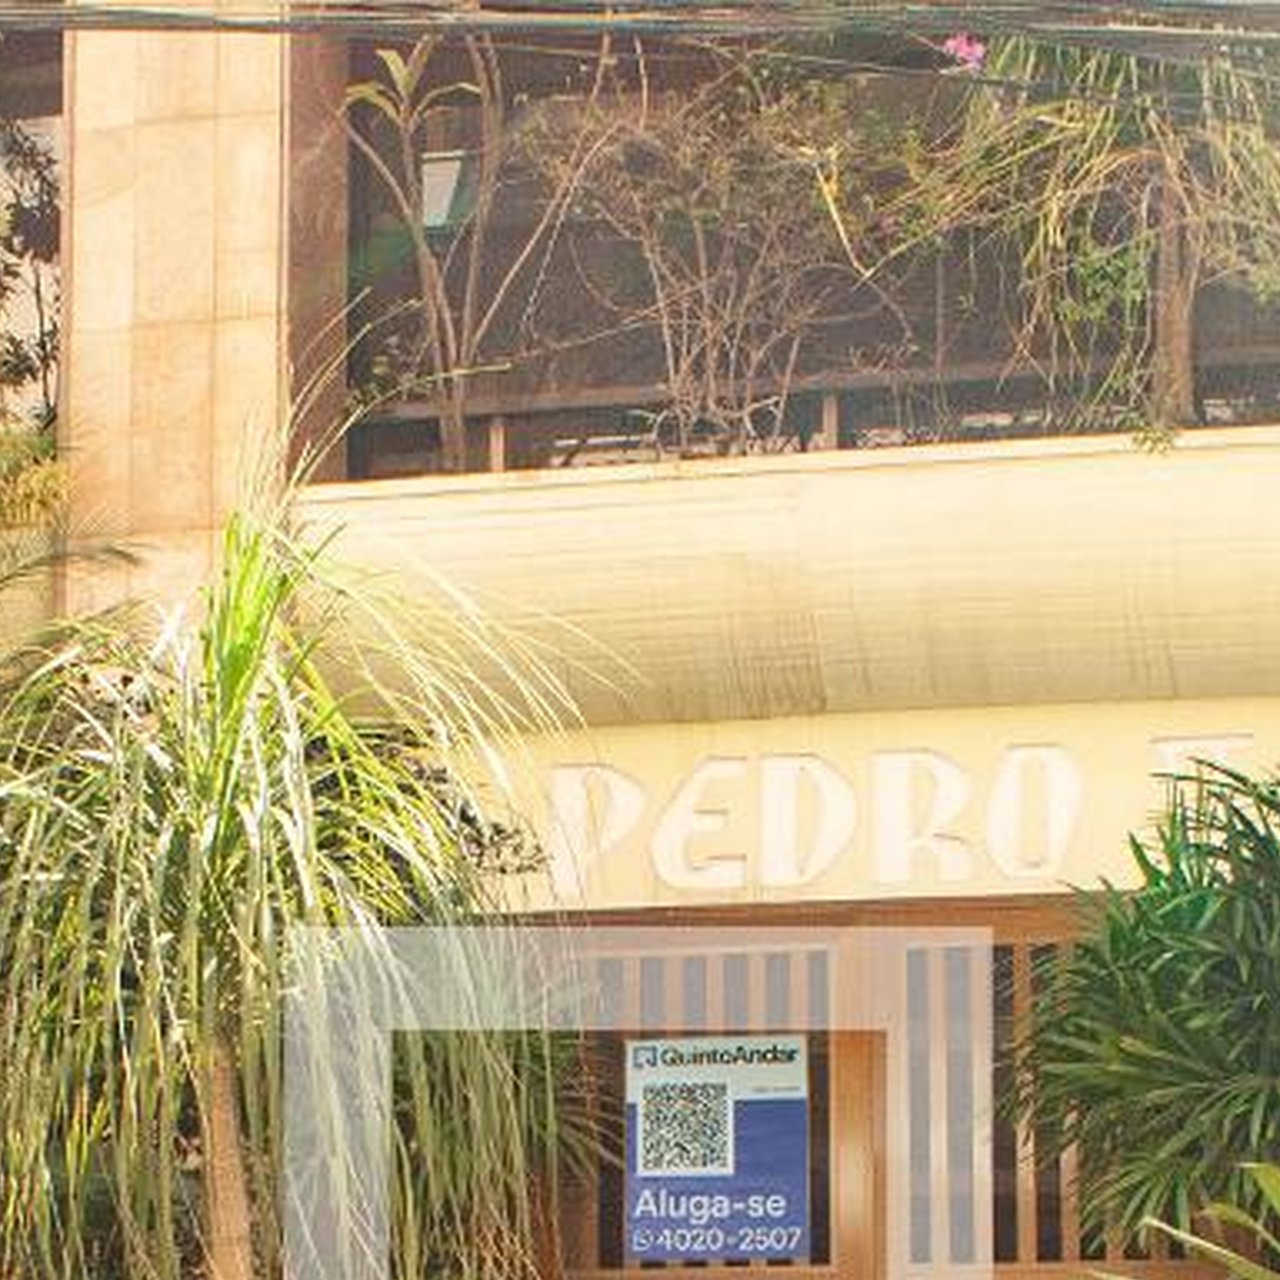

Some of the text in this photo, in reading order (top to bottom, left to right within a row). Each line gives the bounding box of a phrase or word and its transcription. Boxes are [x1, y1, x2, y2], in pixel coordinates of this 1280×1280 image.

[548, 744, 1081, 895] PEDRO
[659, 1045, 798, 1066] QuintoAndar
[634, 1188, 787, 1224] Aluga-se
[656, 1227, 801, 1251] 4020-2507
